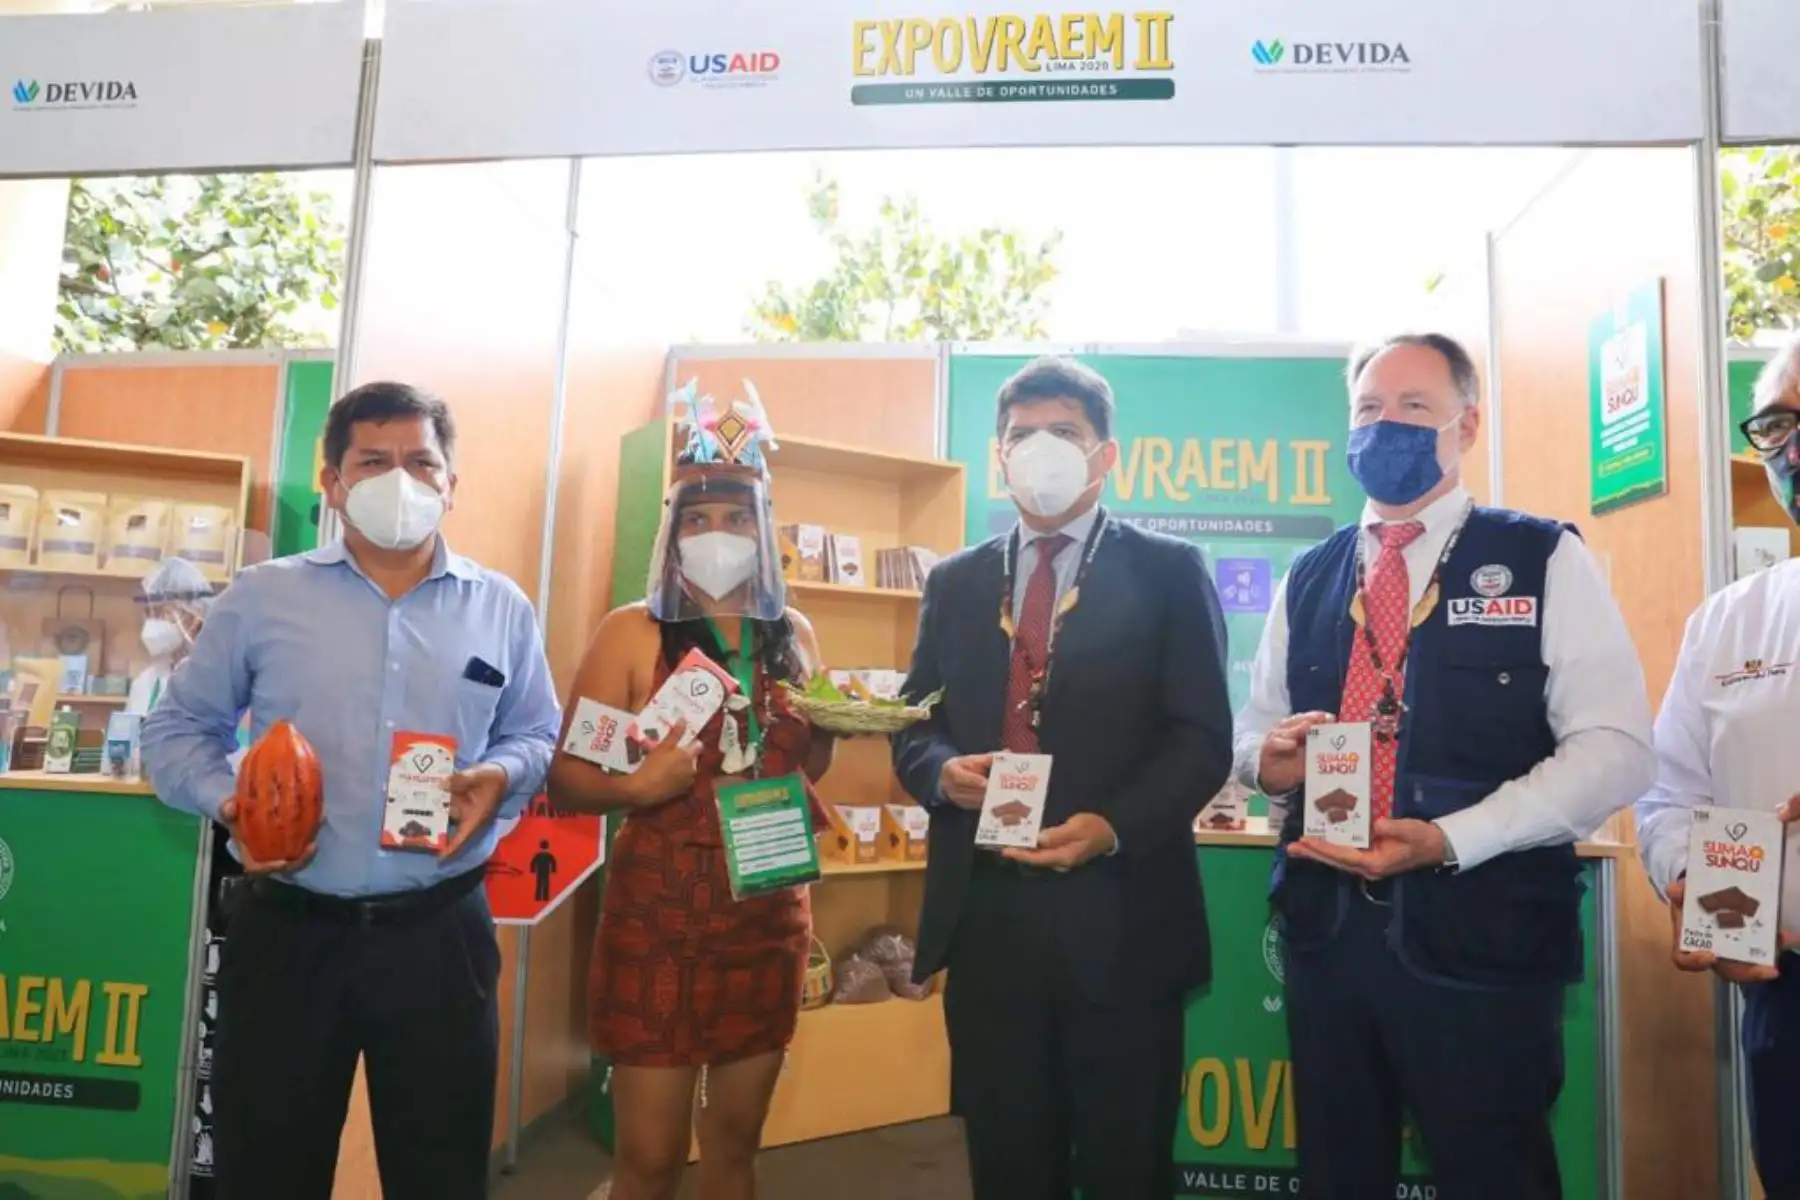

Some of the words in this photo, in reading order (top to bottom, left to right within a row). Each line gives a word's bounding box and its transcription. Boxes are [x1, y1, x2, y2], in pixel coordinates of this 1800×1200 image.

[852, 12, 1125, 77] EXPOVRAEM
[1292, 41, 1411, 65] DEVIDA
[689, 52, 780, 75] USAID
[1045, 60, 1076, 73] LIMA
[45, 80, 138, 104] DEVIDA
[904, 88, 924, 100] UN
[928, 87, 972, 99] VALLE
[976, 86, 996, 98] DE
[999, 84, 1119, 98] OPORTUNIDADES
[1148, 517, 1275, 534] OPORTUNIDADES
[1451, 599, 1533, 615] USAID
[0, 1079, 74, 1099] NIDADES
[1183, 1170, 1246, 1191] VALLE
[1254, 1174, 1281, 1193] DE
